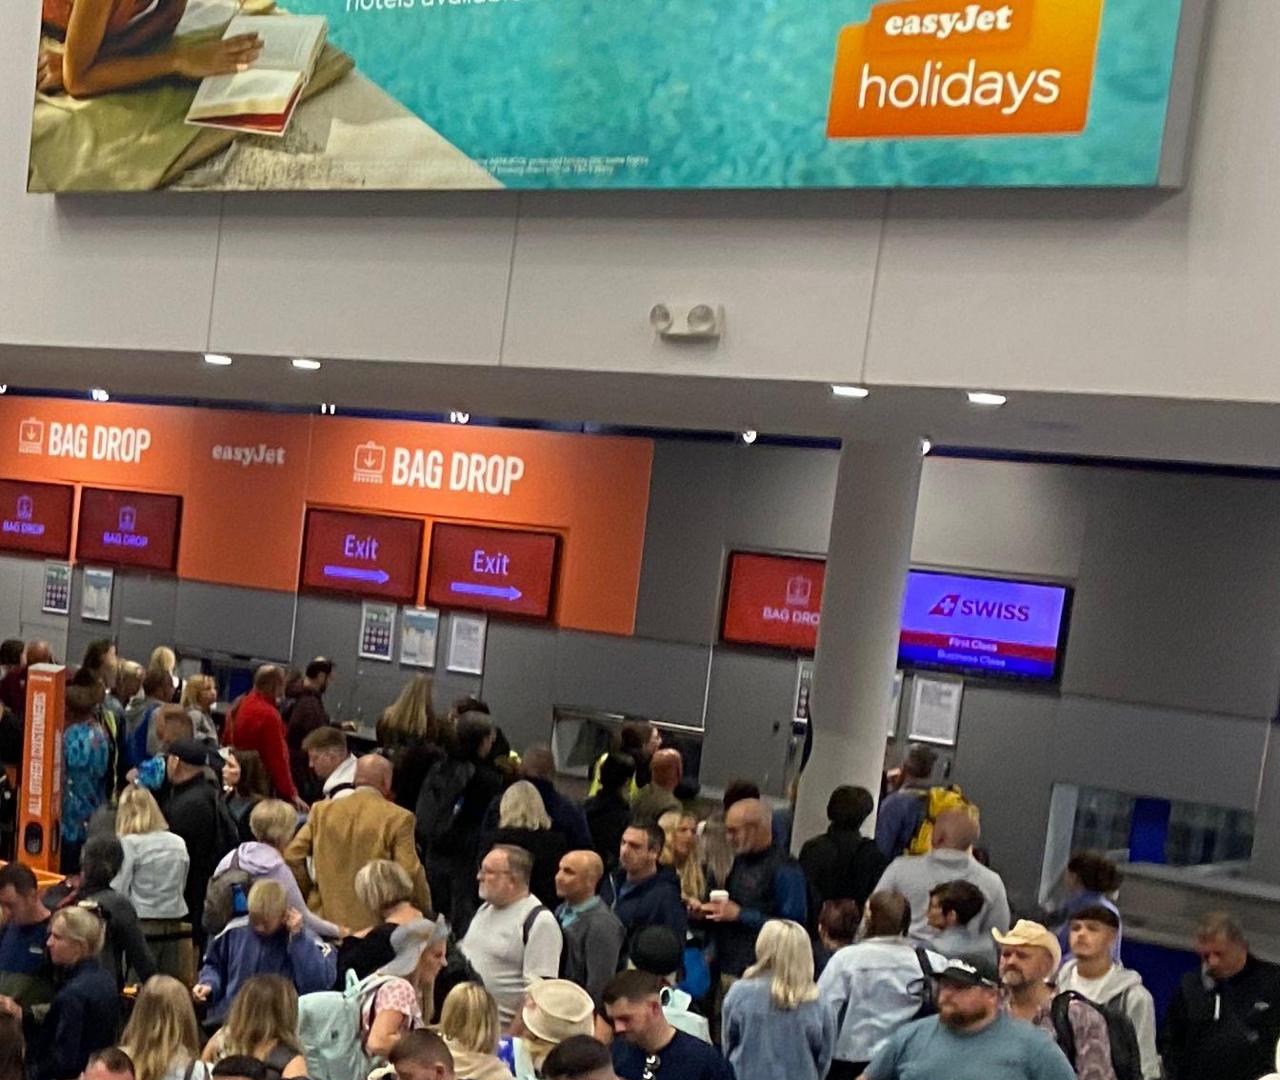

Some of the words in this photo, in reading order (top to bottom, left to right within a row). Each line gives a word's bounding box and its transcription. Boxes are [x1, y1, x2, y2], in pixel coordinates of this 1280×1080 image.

[885, 5, 1013, 38] easyJet
[858, 59, 1061, 115] holidays
[48, 422, 88, 459] BAG
[92, 425, 150, 463] DROP
[212, 443, 286, 465] easyJet
[392, 447, 444, 490] BAG
[449, 452, 524, 496] DROP
[2, 520, 20, 533] BAG
[21, 522, 45, 536] DROP
[103, 531, 122, 545] BAG
[123, 533, 148, 547] DROP
[344, 534, 380, 561] Exit
[473, 549, 511, 576] Exit
[762, 606, 790, 623] BAG
[961, 600, 1030, 622] SWISS
[948, 636, 970, 649] First
[971, 638, 998, 652] Class
[979, 653, 1006, 667] Class
